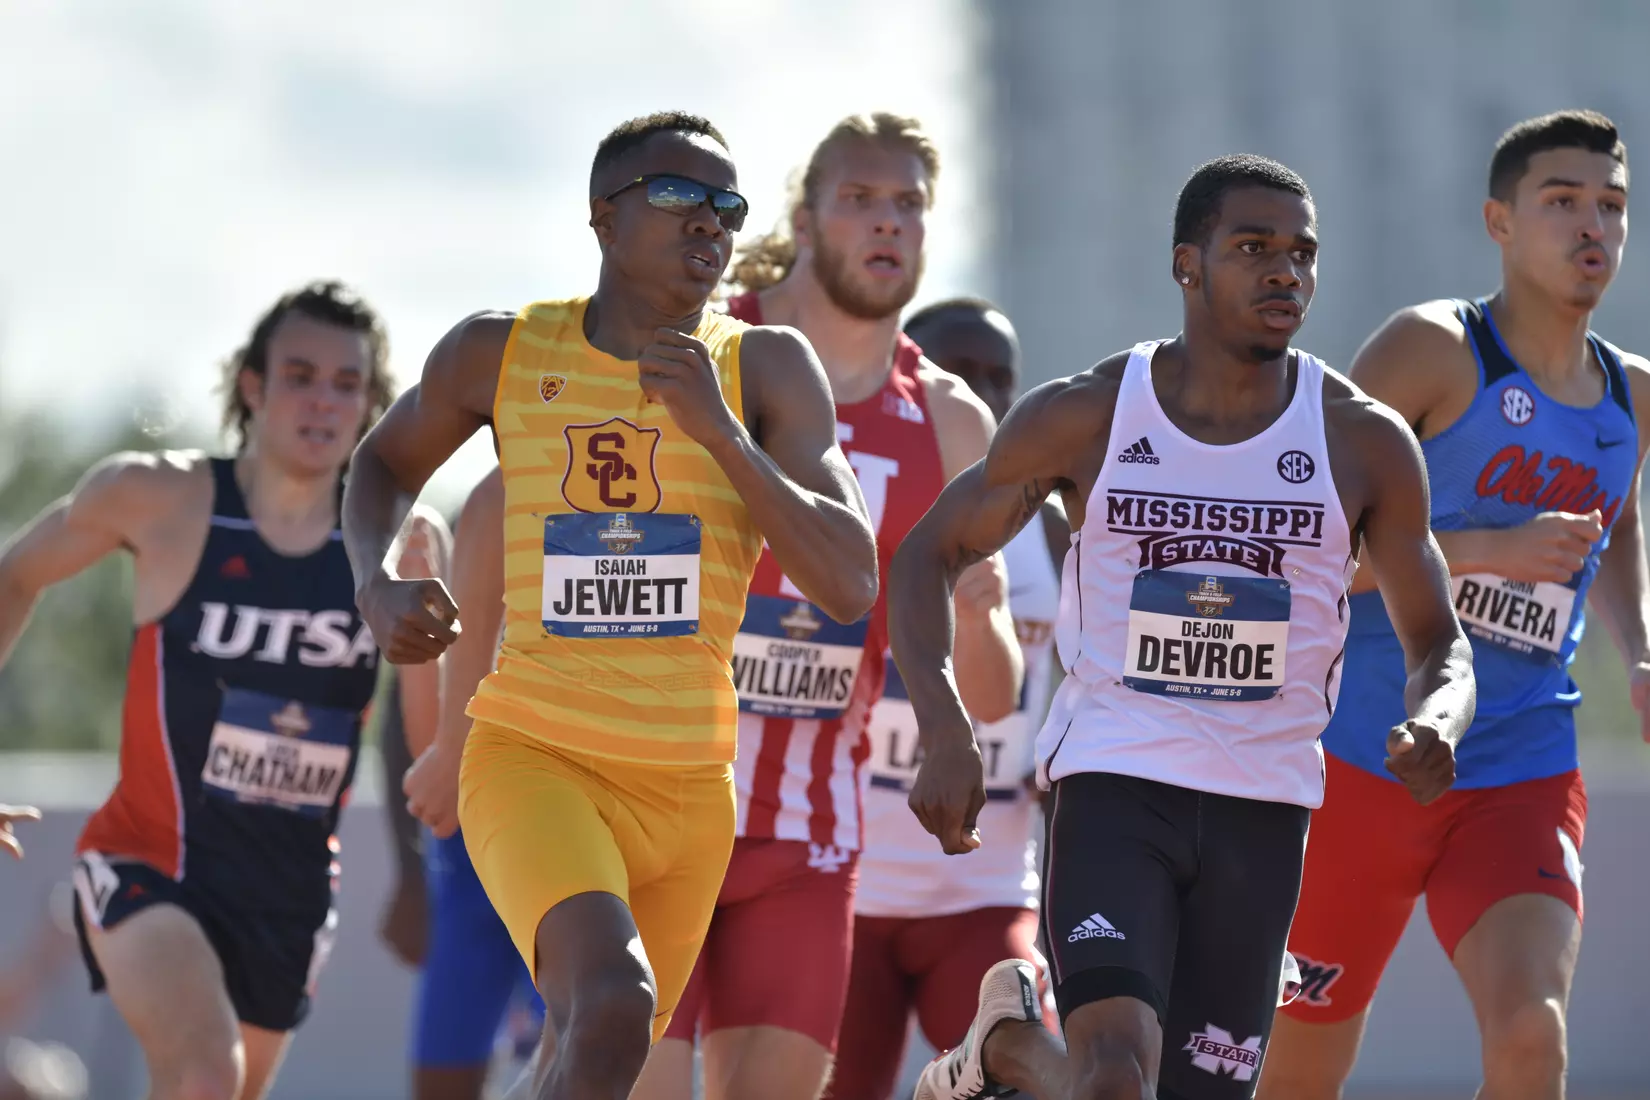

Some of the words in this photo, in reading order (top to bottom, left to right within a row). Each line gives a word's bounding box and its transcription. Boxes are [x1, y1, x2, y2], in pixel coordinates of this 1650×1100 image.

[543, 387, 556, 397] 12
[1503, 387, 1533, 424] SEC
[1118, 453, 1160, 465] adidas
[1281, 453, 1311, 480] SEC
[1476, 445, 1544, 506] Ole
[1106, 496, 1325, 539] MISSISSIPPI
[1161, 540, 1259, 567] STATE
[595, 559, 646, 576] ISAIAH
[553, 577, 688, 616] JEWETT
[1455, 579, 1557, 642] RIVERA
[583, 625, 609, 633] AUSTIN,
[628, 625, 646, 633] JUNE
[1181, 620, 1234, 640] DEJON
[1136, 634, 1275, 681] DEVROE
[1165, 684, 1191, 695] AUSTIN,
[1210, 687, 1228, 696] JUNE
[211, 744, 338, 796] CHATHAM
[1067, 927, 1126, 943] adidas
[1203, 1042, 1255, 1065] STATE
